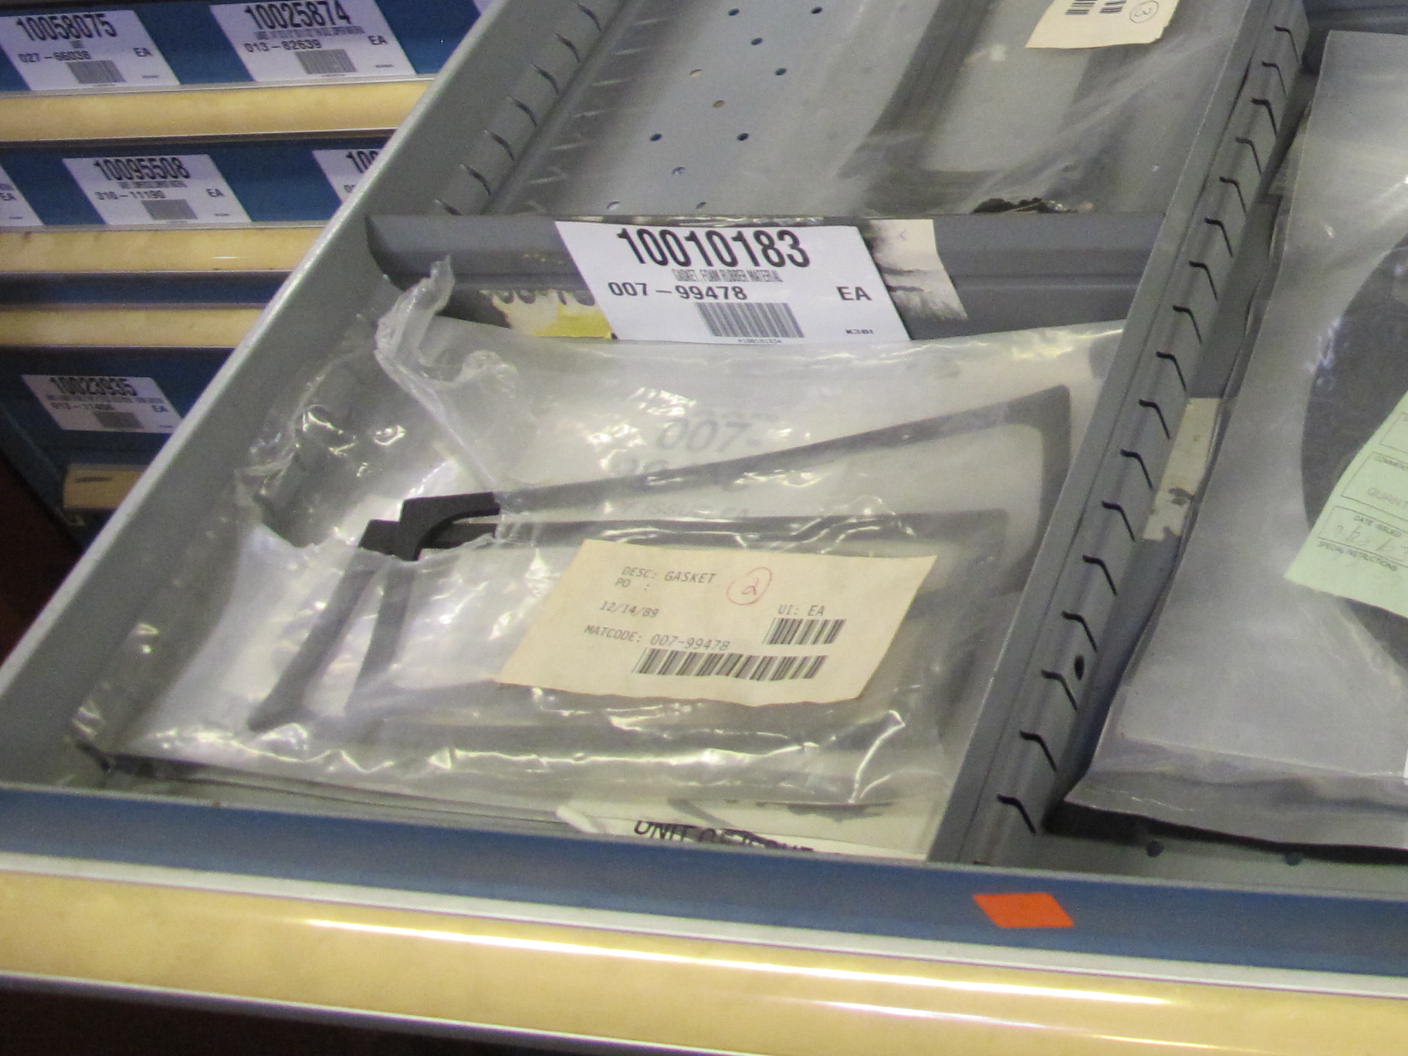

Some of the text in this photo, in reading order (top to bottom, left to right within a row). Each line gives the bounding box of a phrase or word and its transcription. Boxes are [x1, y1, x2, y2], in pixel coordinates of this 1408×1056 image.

[244, 0, 352, 30] 10025874
[16, 13, 117, 41] 10058075
[368, 35, 388, 46] EA
[133, 47, 153, 57] EA
[93, 157, 191, 181] 10095508
[206, 188, 225, 198] EA
[617, 227, 810, 267] 10010183
[836, 286, 872, 301] EA
[615, 577, 630, 589] PO
[621, 566, 717, 584] DESC: GASKET
[807, 605, 826, 616] EA
[584, 625, 731, 652] MATCODE: 007-99478
